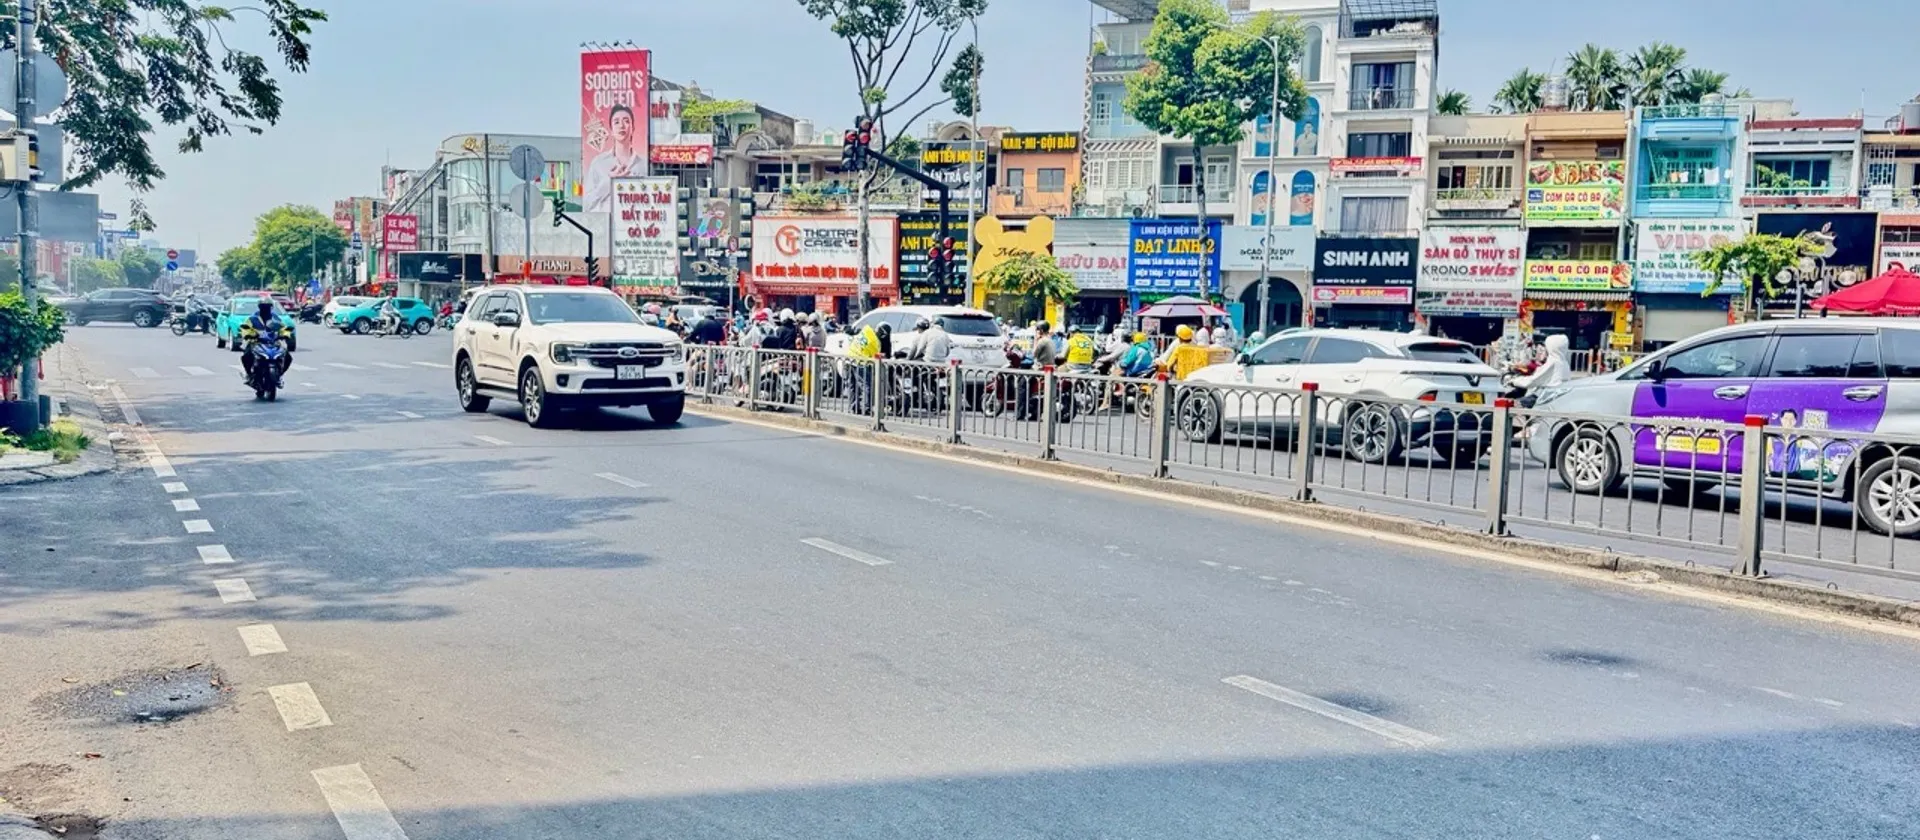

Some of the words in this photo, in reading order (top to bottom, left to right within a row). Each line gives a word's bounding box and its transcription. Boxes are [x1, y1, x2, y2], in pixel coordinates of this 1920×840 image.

[585, 70, 644, 91] SOOBIN'S
[594, 89, 635, 112] QUEEN
[1167, 239, 1200, 254] LINH
[1207, 239, 1215, 254] 2
[1323, 251, 1368, 267] SINH
[1369, 251, 1410, 267] ANH
